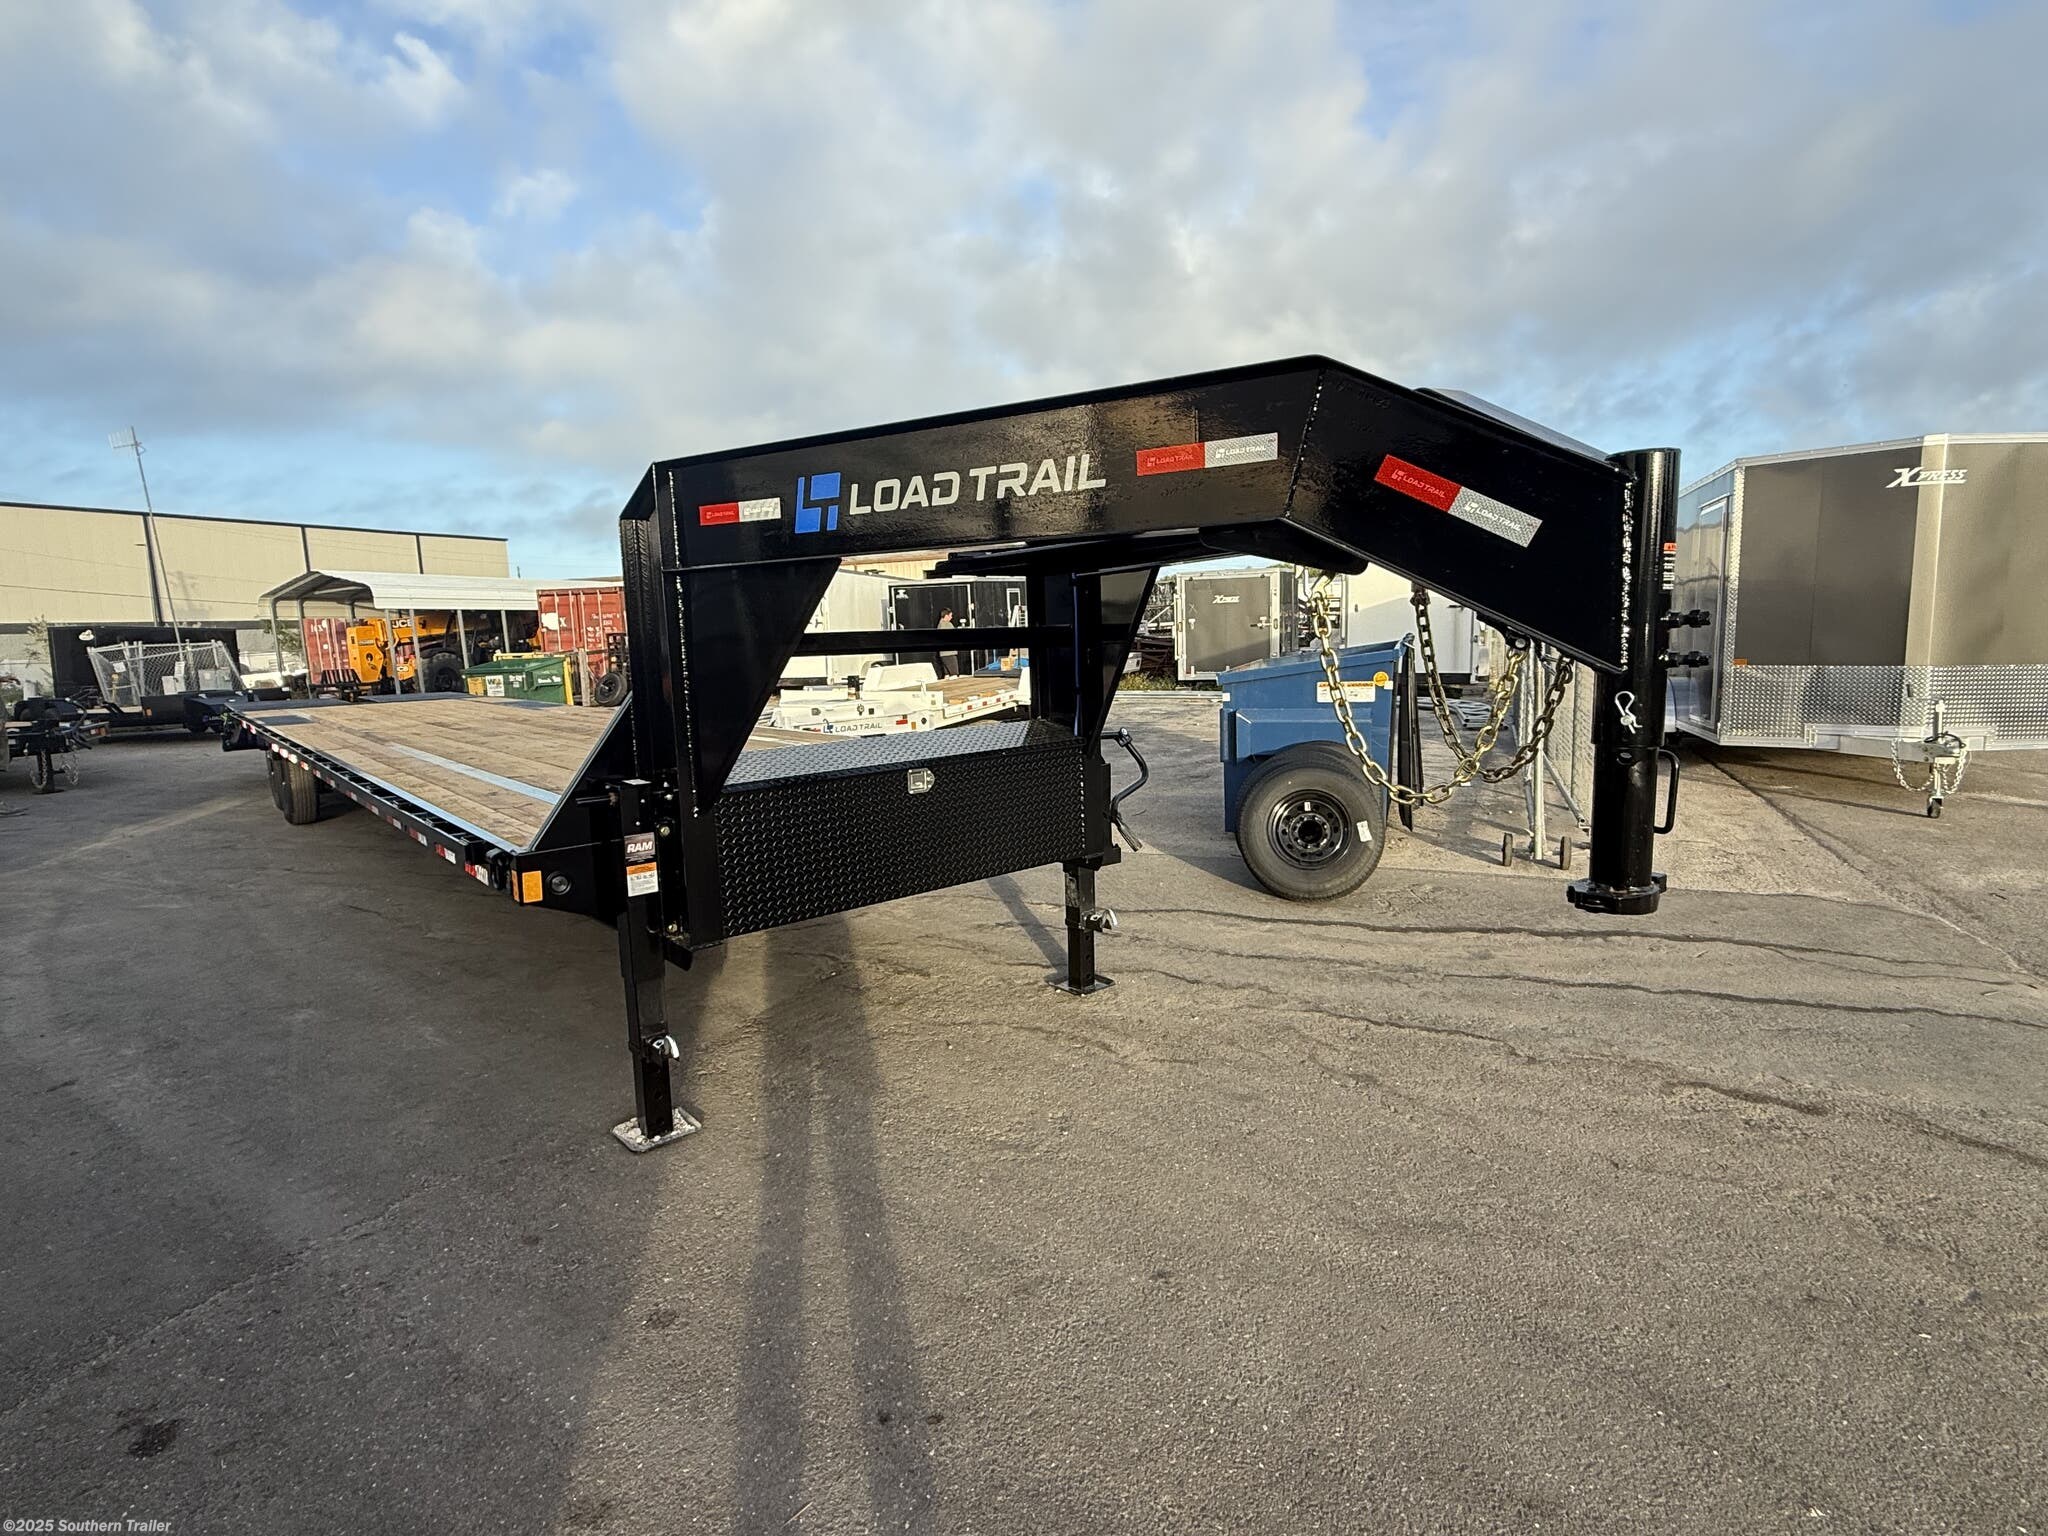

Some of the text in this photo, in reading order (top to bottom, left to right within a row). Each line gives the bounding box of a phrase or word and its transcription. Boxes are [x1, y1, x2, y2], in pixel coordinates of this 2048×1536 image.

[849, 453, 1107, 515] LOAD TRAIL
[1402, 475, 1446, 498] LOAD TRAIL
[1885, 466, 1968, 488] XPRESS
[1476, 507, 1522, 531] LOAD TRAIL
[835, 722, 882, 733] LOAD TRAIL
[627, 841, 653, 853] RAM
